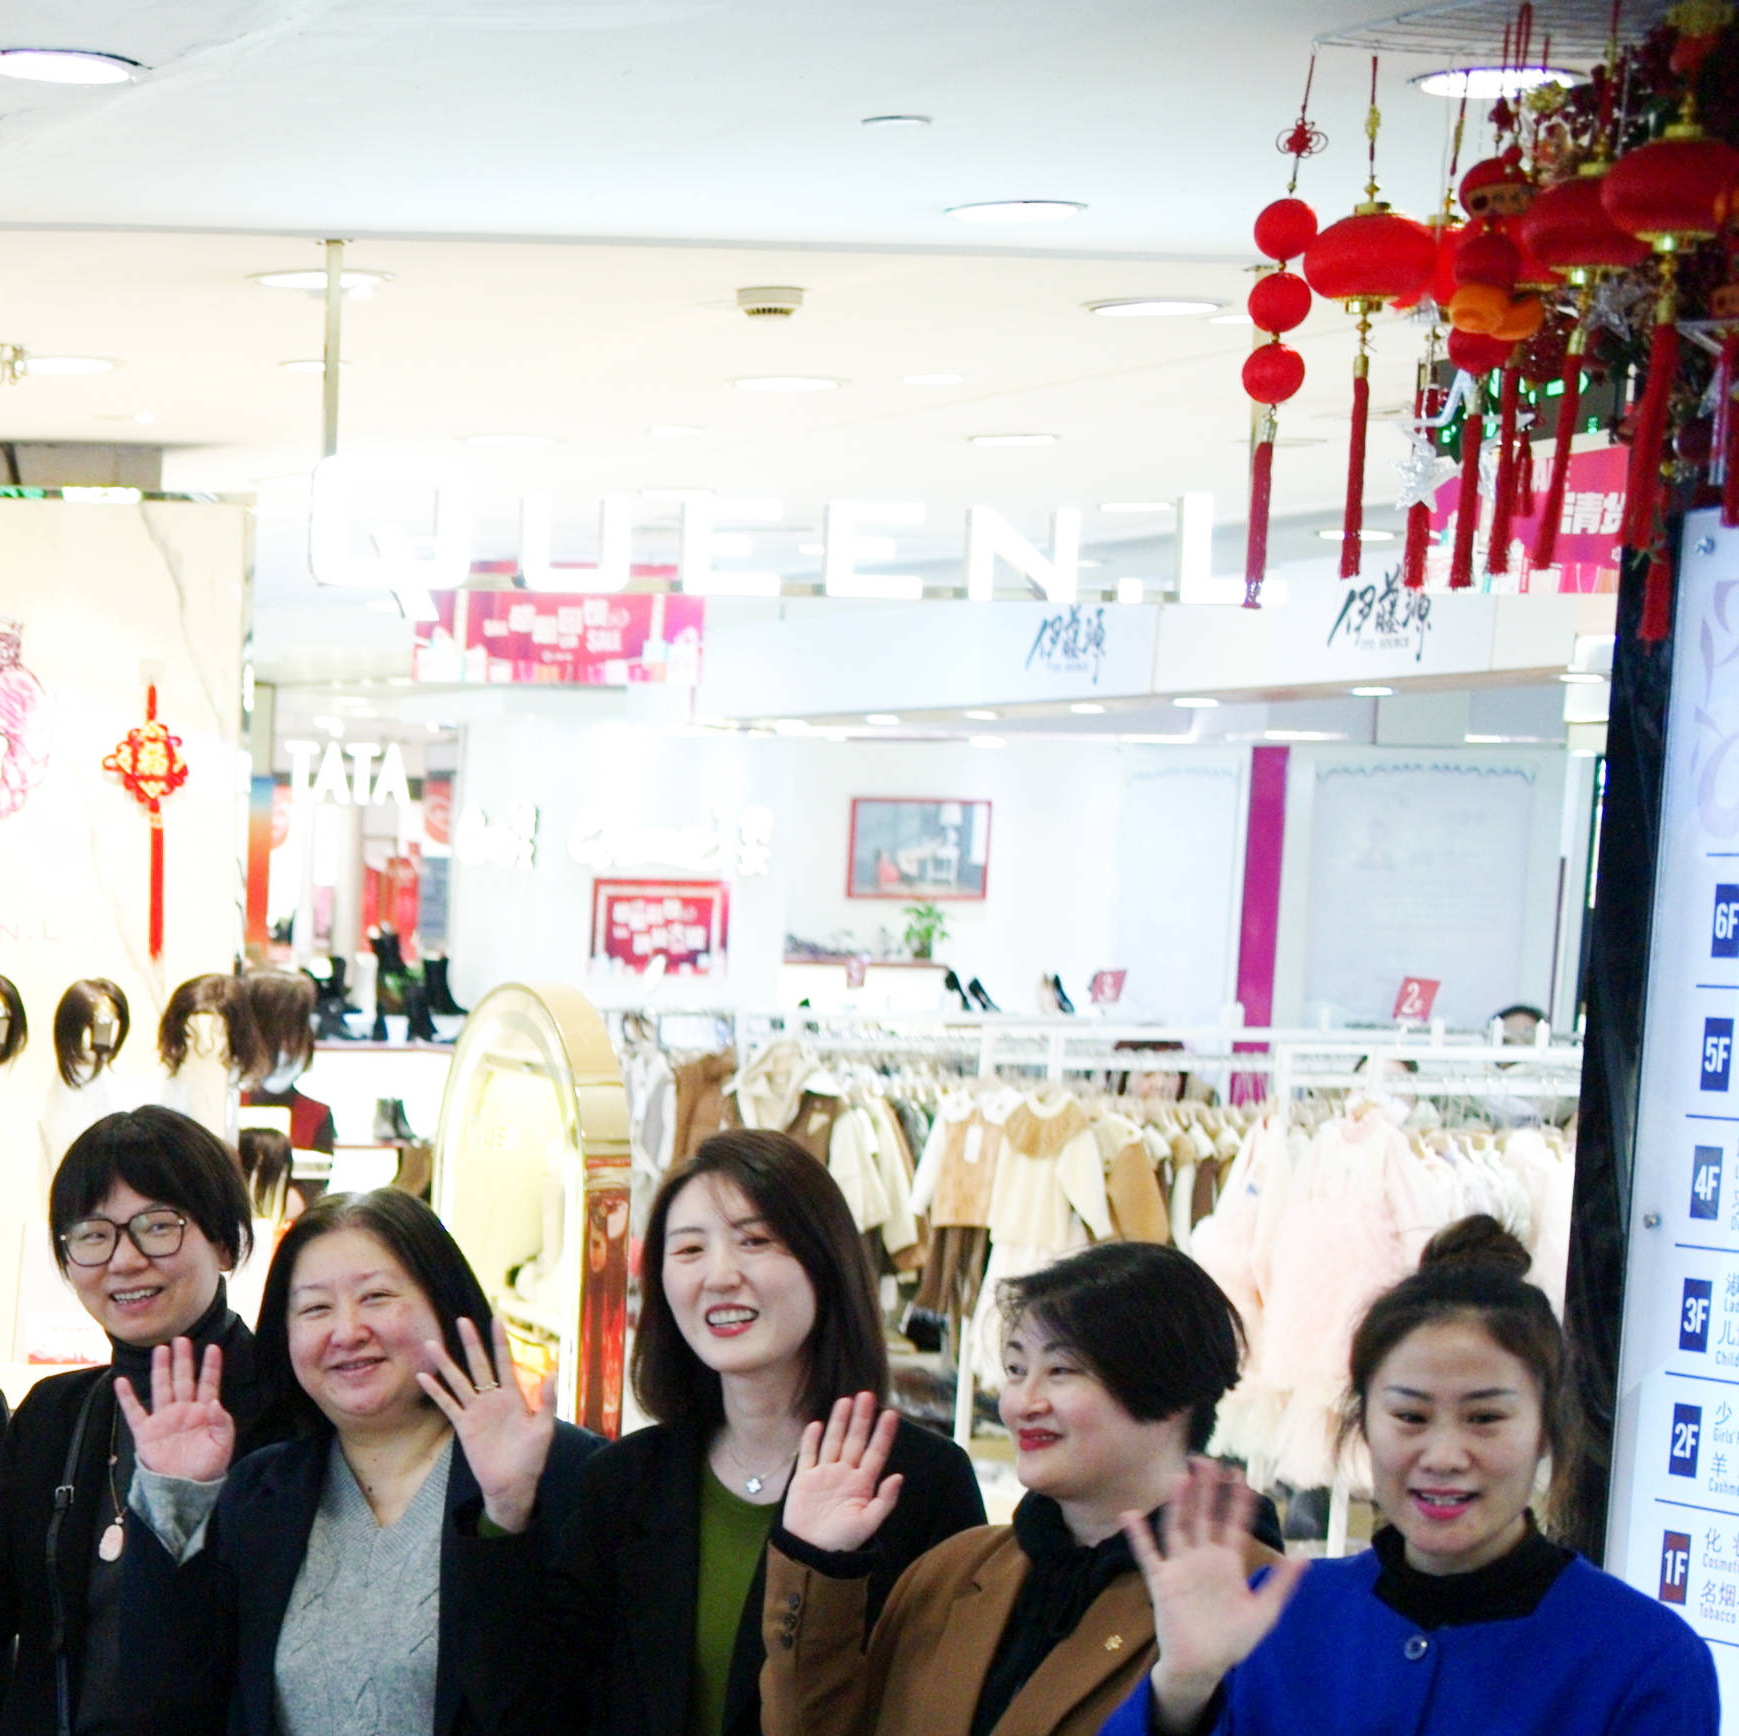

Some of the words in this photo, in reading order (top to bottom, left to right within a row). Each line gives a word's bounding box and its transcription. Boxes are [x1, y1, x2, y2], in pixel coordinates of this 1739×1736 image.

[284, 740, 411, 806] TATA
[1714, 901, 1739, 940] 6F
[1704, 1036, 1732, 1073] 5F
[1694, 1165, 1721, 1202] 4F
[1683, 1297, 1709, 1335] 3F
[1673, 1422, 1699, 1459] 2F
[1664, 1549, 1688, 1587] 1F
